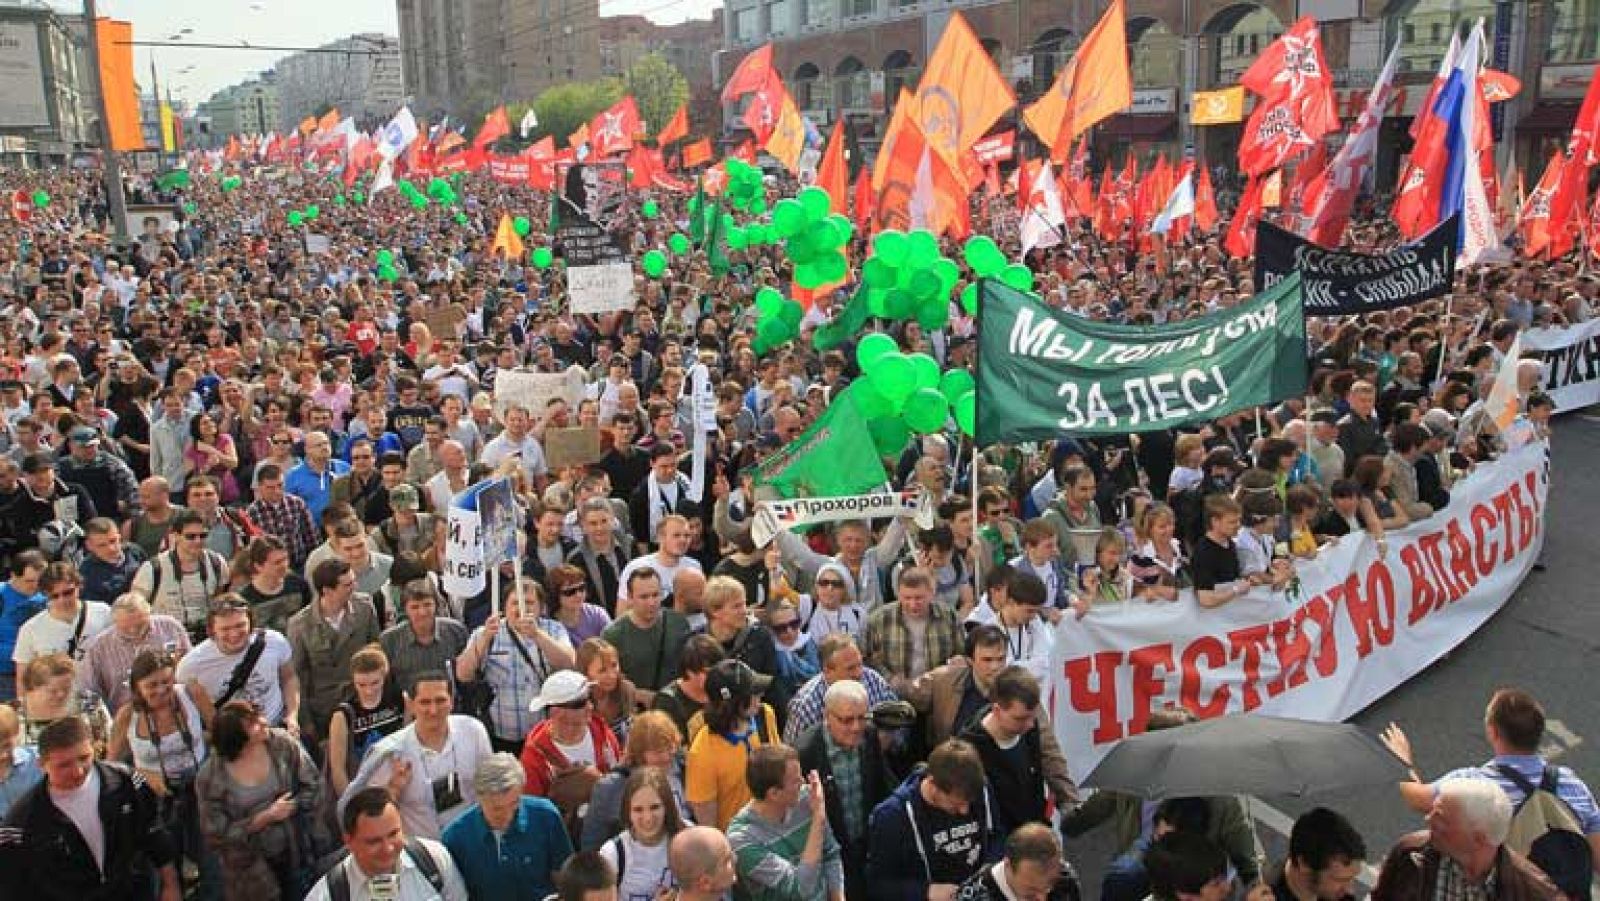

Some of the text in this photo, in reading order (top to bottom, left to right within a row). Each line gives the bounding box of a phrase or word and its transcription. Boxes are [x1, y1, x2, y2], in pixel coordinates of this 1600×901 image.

[1009, 307, 1092, 362] Мы
[1058, 365, 1230, 428] ЗА ЛЕС!
[794, 495, 893, 515] Прохоров
[1064, 470, 1540, 746] ЧЕСТНУЮ ВЛАСТЬ!
